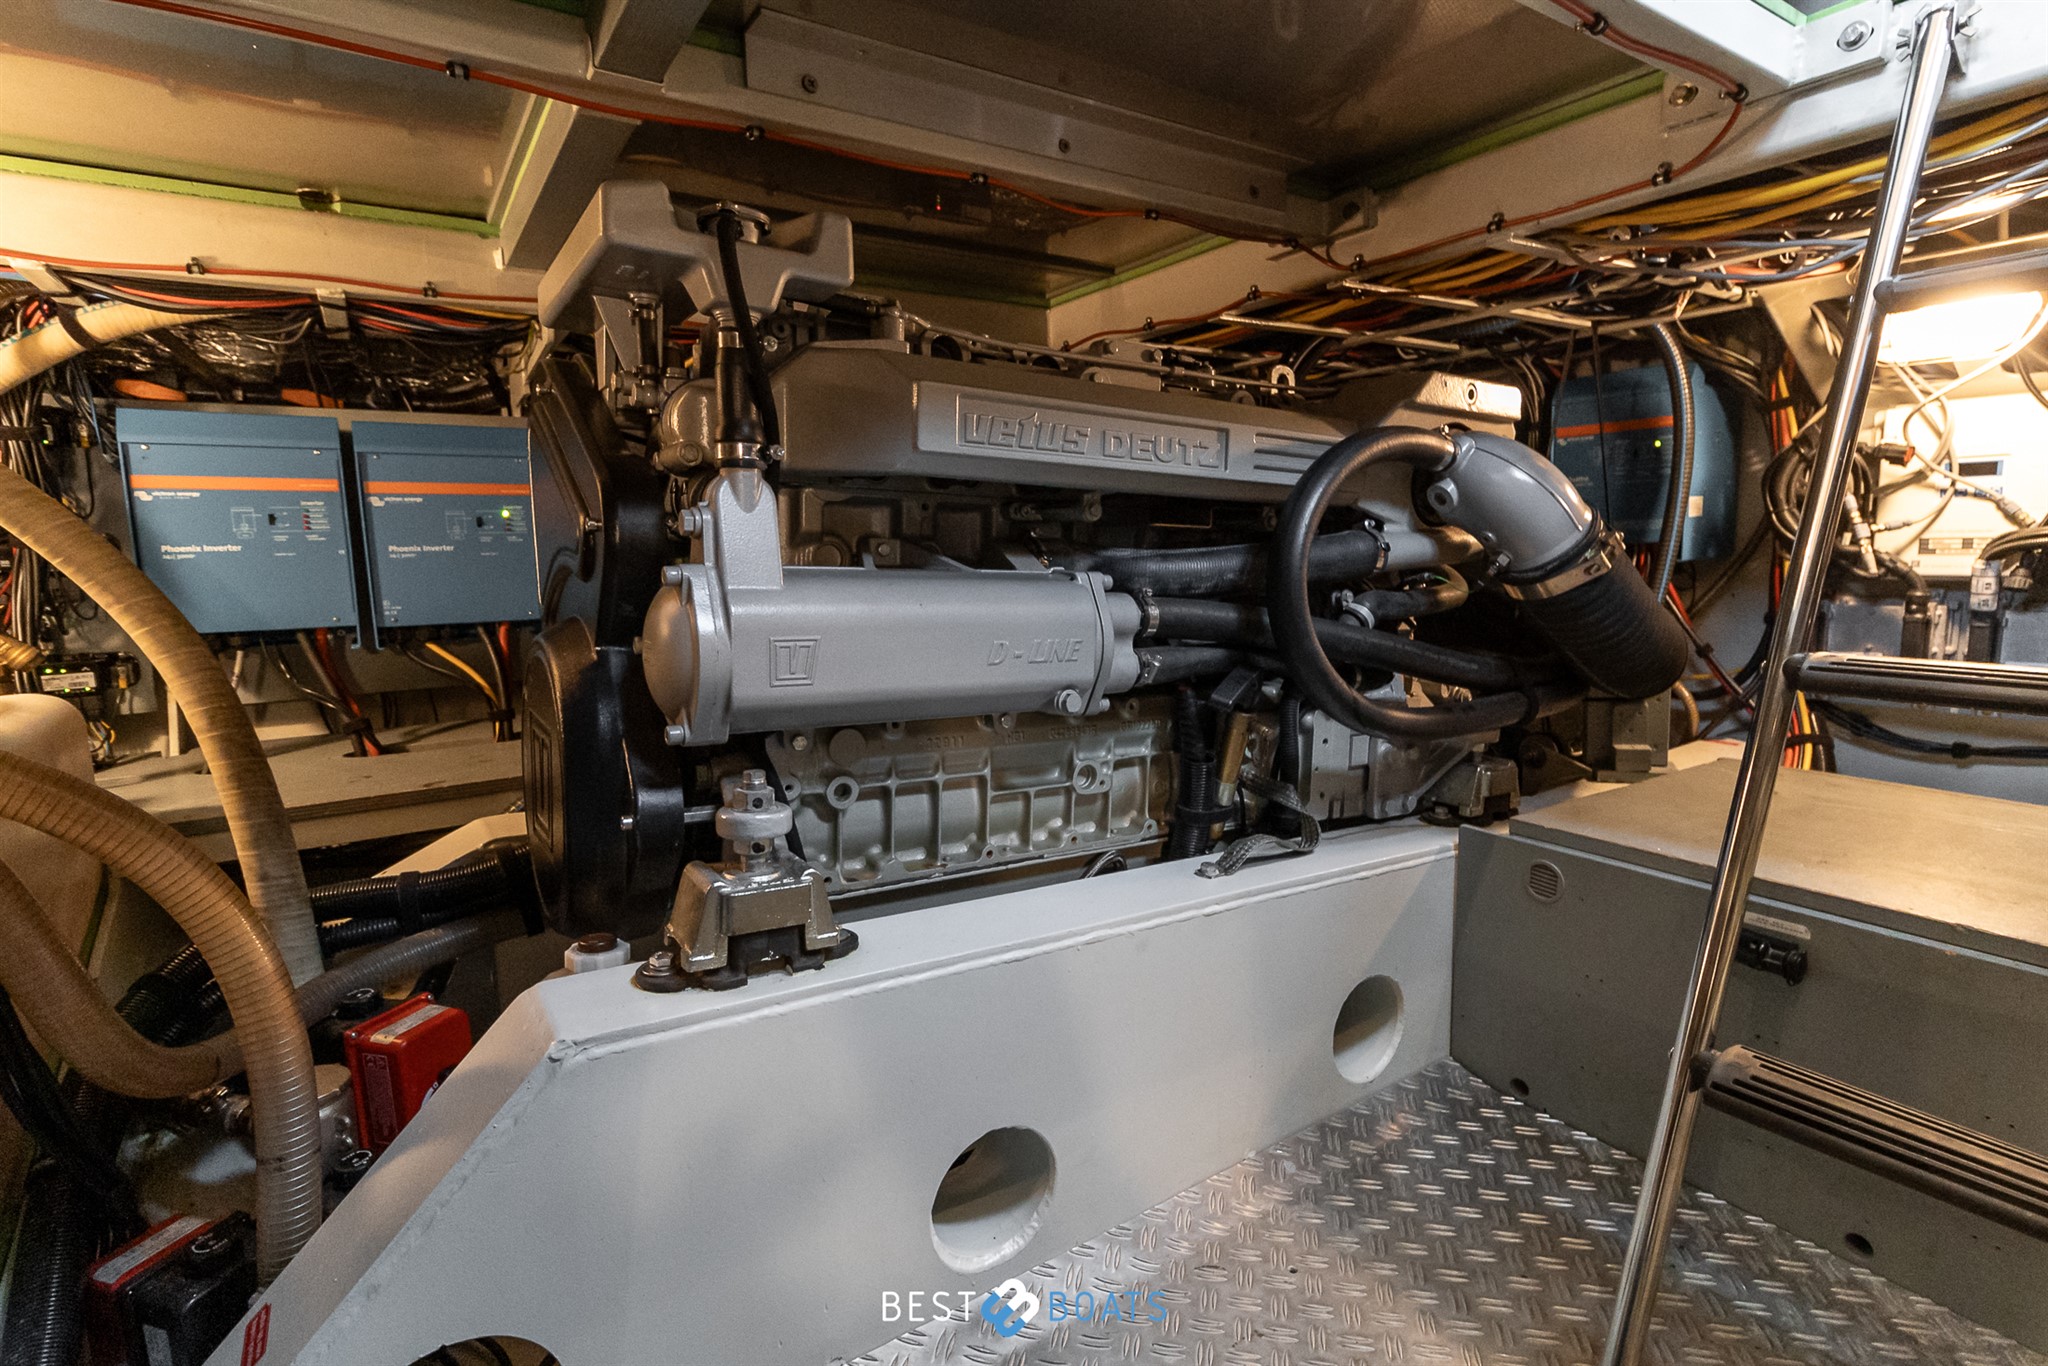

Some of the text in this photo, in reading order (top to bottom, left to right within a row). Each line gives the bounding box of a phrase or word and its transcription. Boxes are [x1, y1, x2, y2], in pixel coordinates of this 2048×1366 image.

[964, 412, 1220, 469] vetus DEUTZ
[160, 545, 242, 553] Phoenix Inverter
